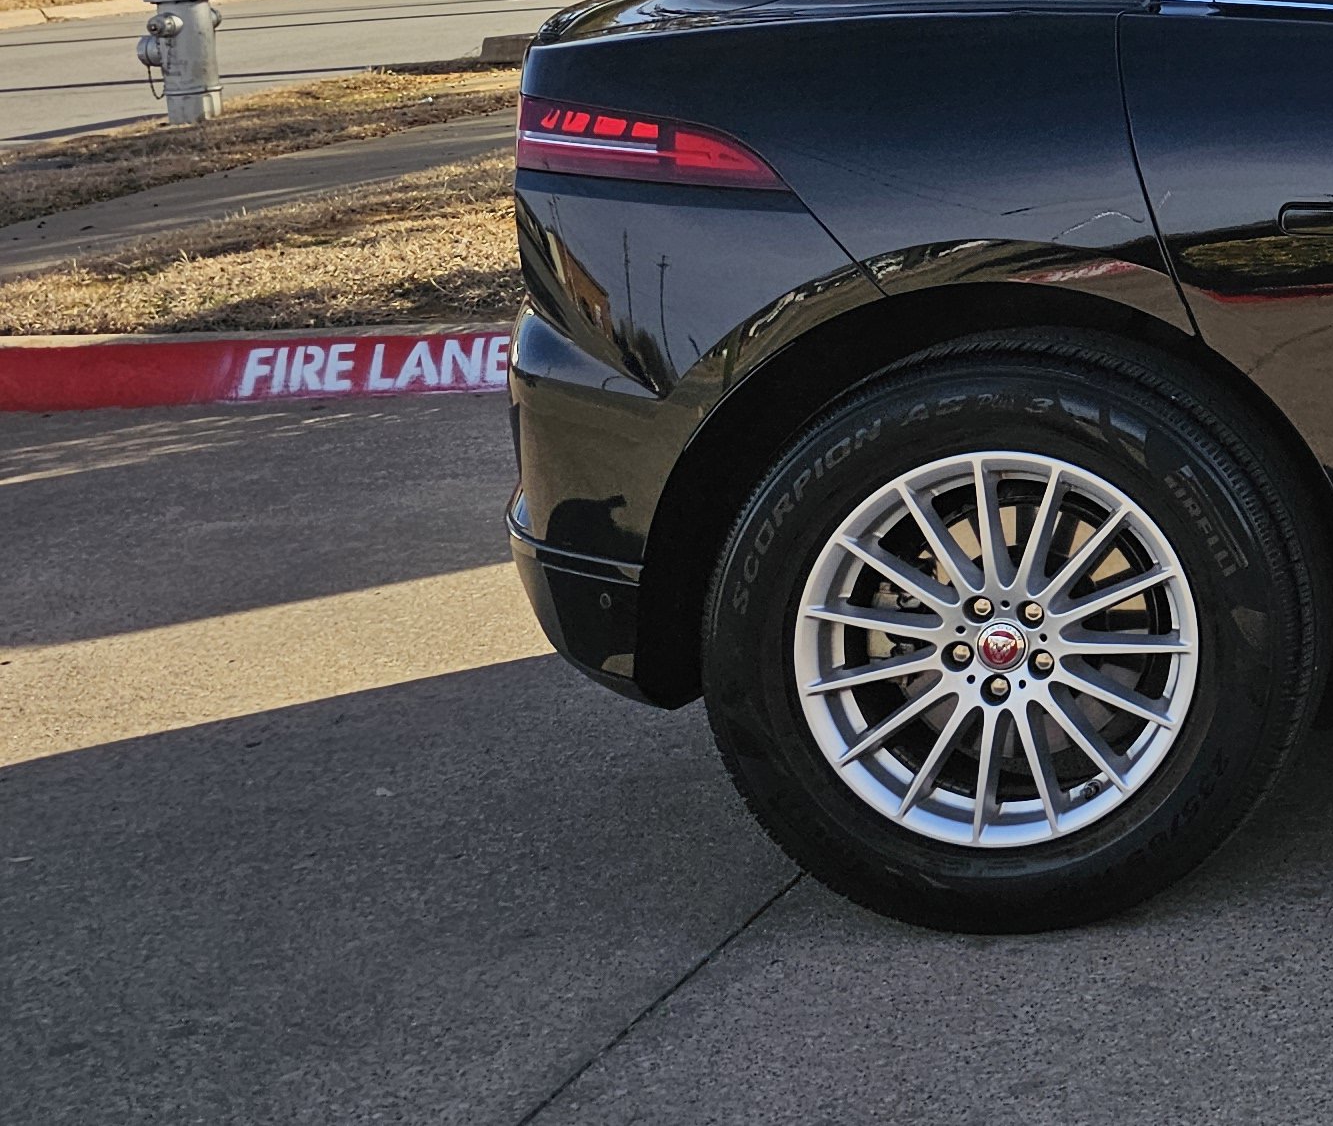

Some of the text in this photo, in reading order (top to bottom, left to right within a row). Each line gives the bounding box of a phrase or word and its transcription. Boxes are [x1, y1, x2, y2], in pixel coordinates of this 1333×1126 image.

[238, 336, 510, 397] FIRE LANE
[732, 418, 881, 615] SCORPION
[1163, 464, 1249, 578] PIRELLI
